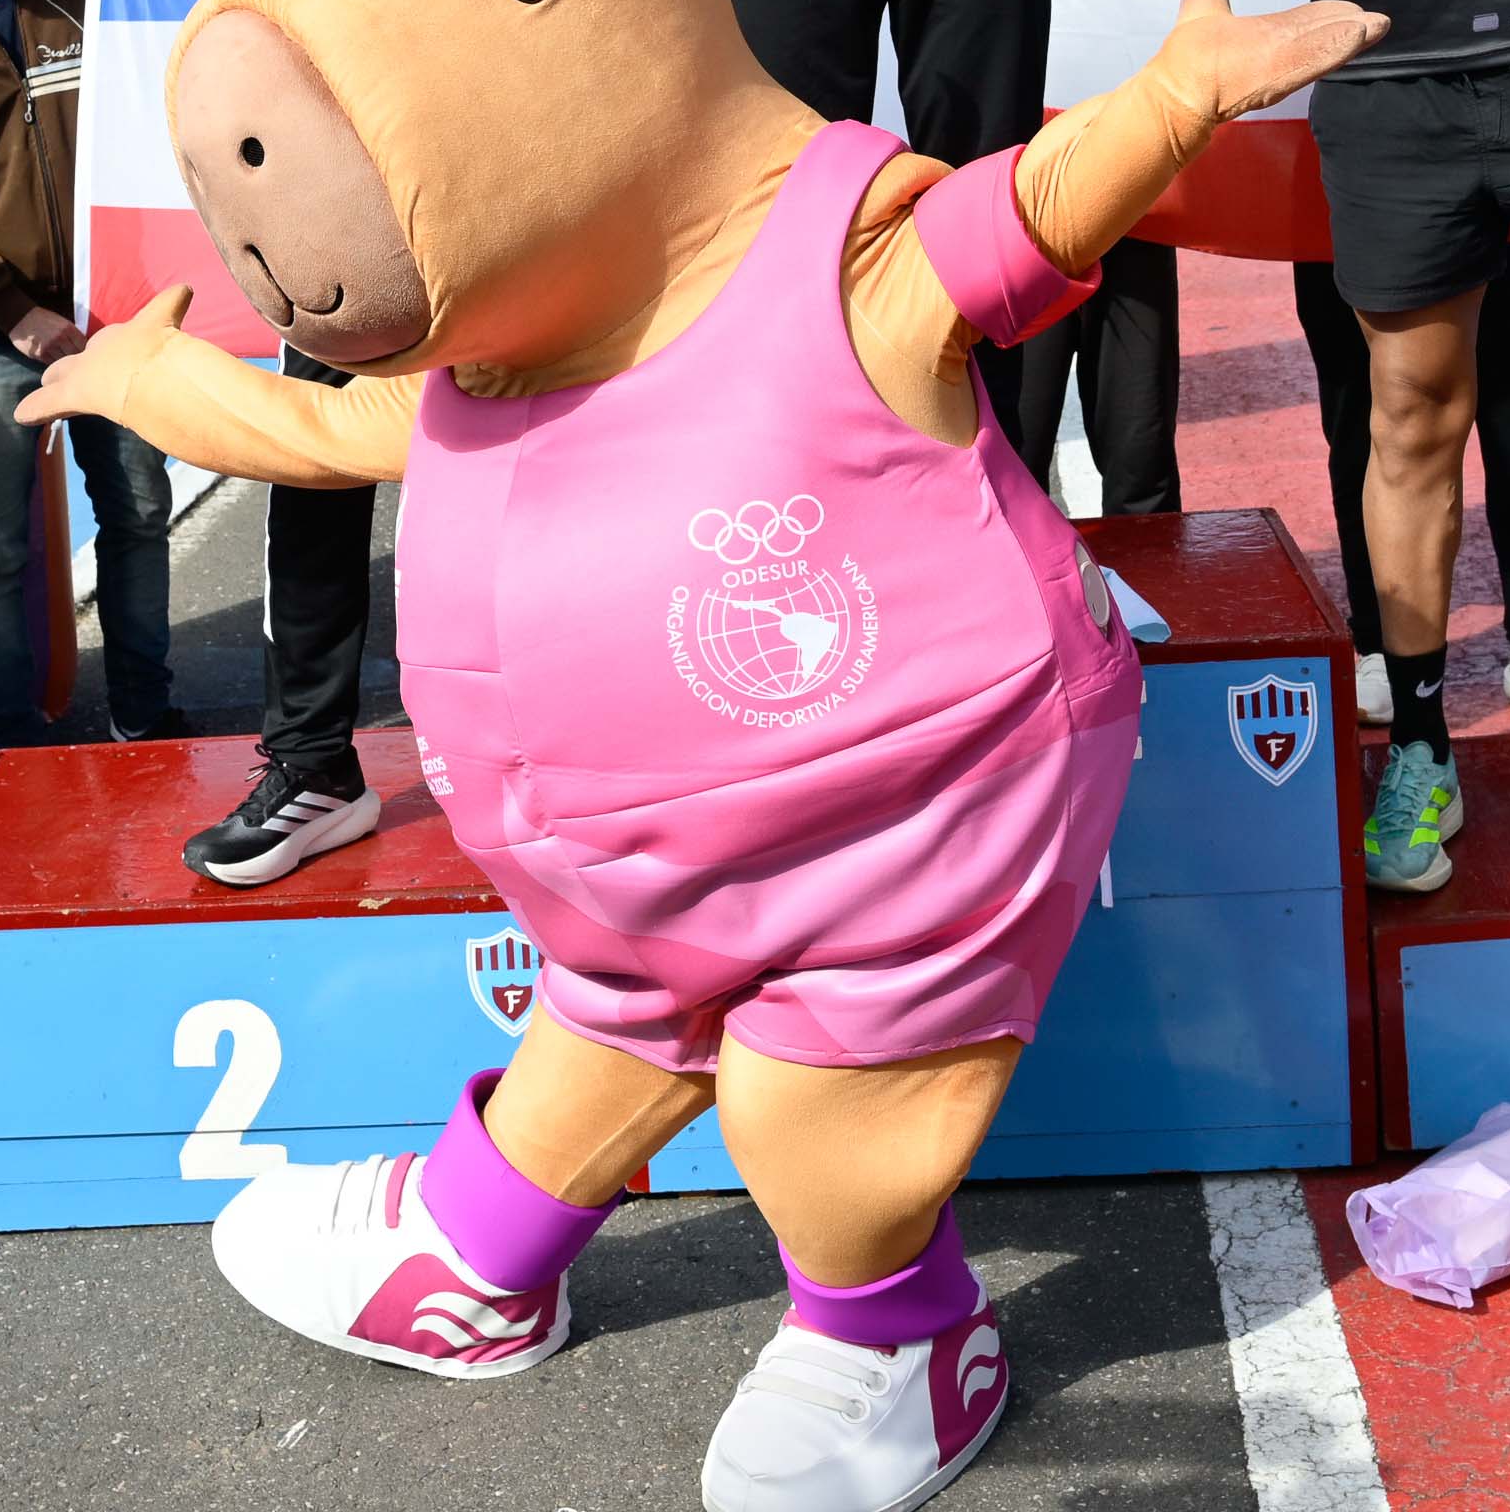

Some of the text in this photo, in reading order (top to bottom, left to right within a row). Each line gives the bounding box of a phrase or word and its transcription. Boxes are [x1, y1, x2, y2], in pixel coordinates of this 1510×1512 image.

[666, 553, 879, 729] ORGANIZACION DEPORTIVA SURAMERICANA
[722, 559, 810, 589] ODESUR
[173, 999, 288, 1181] 2
